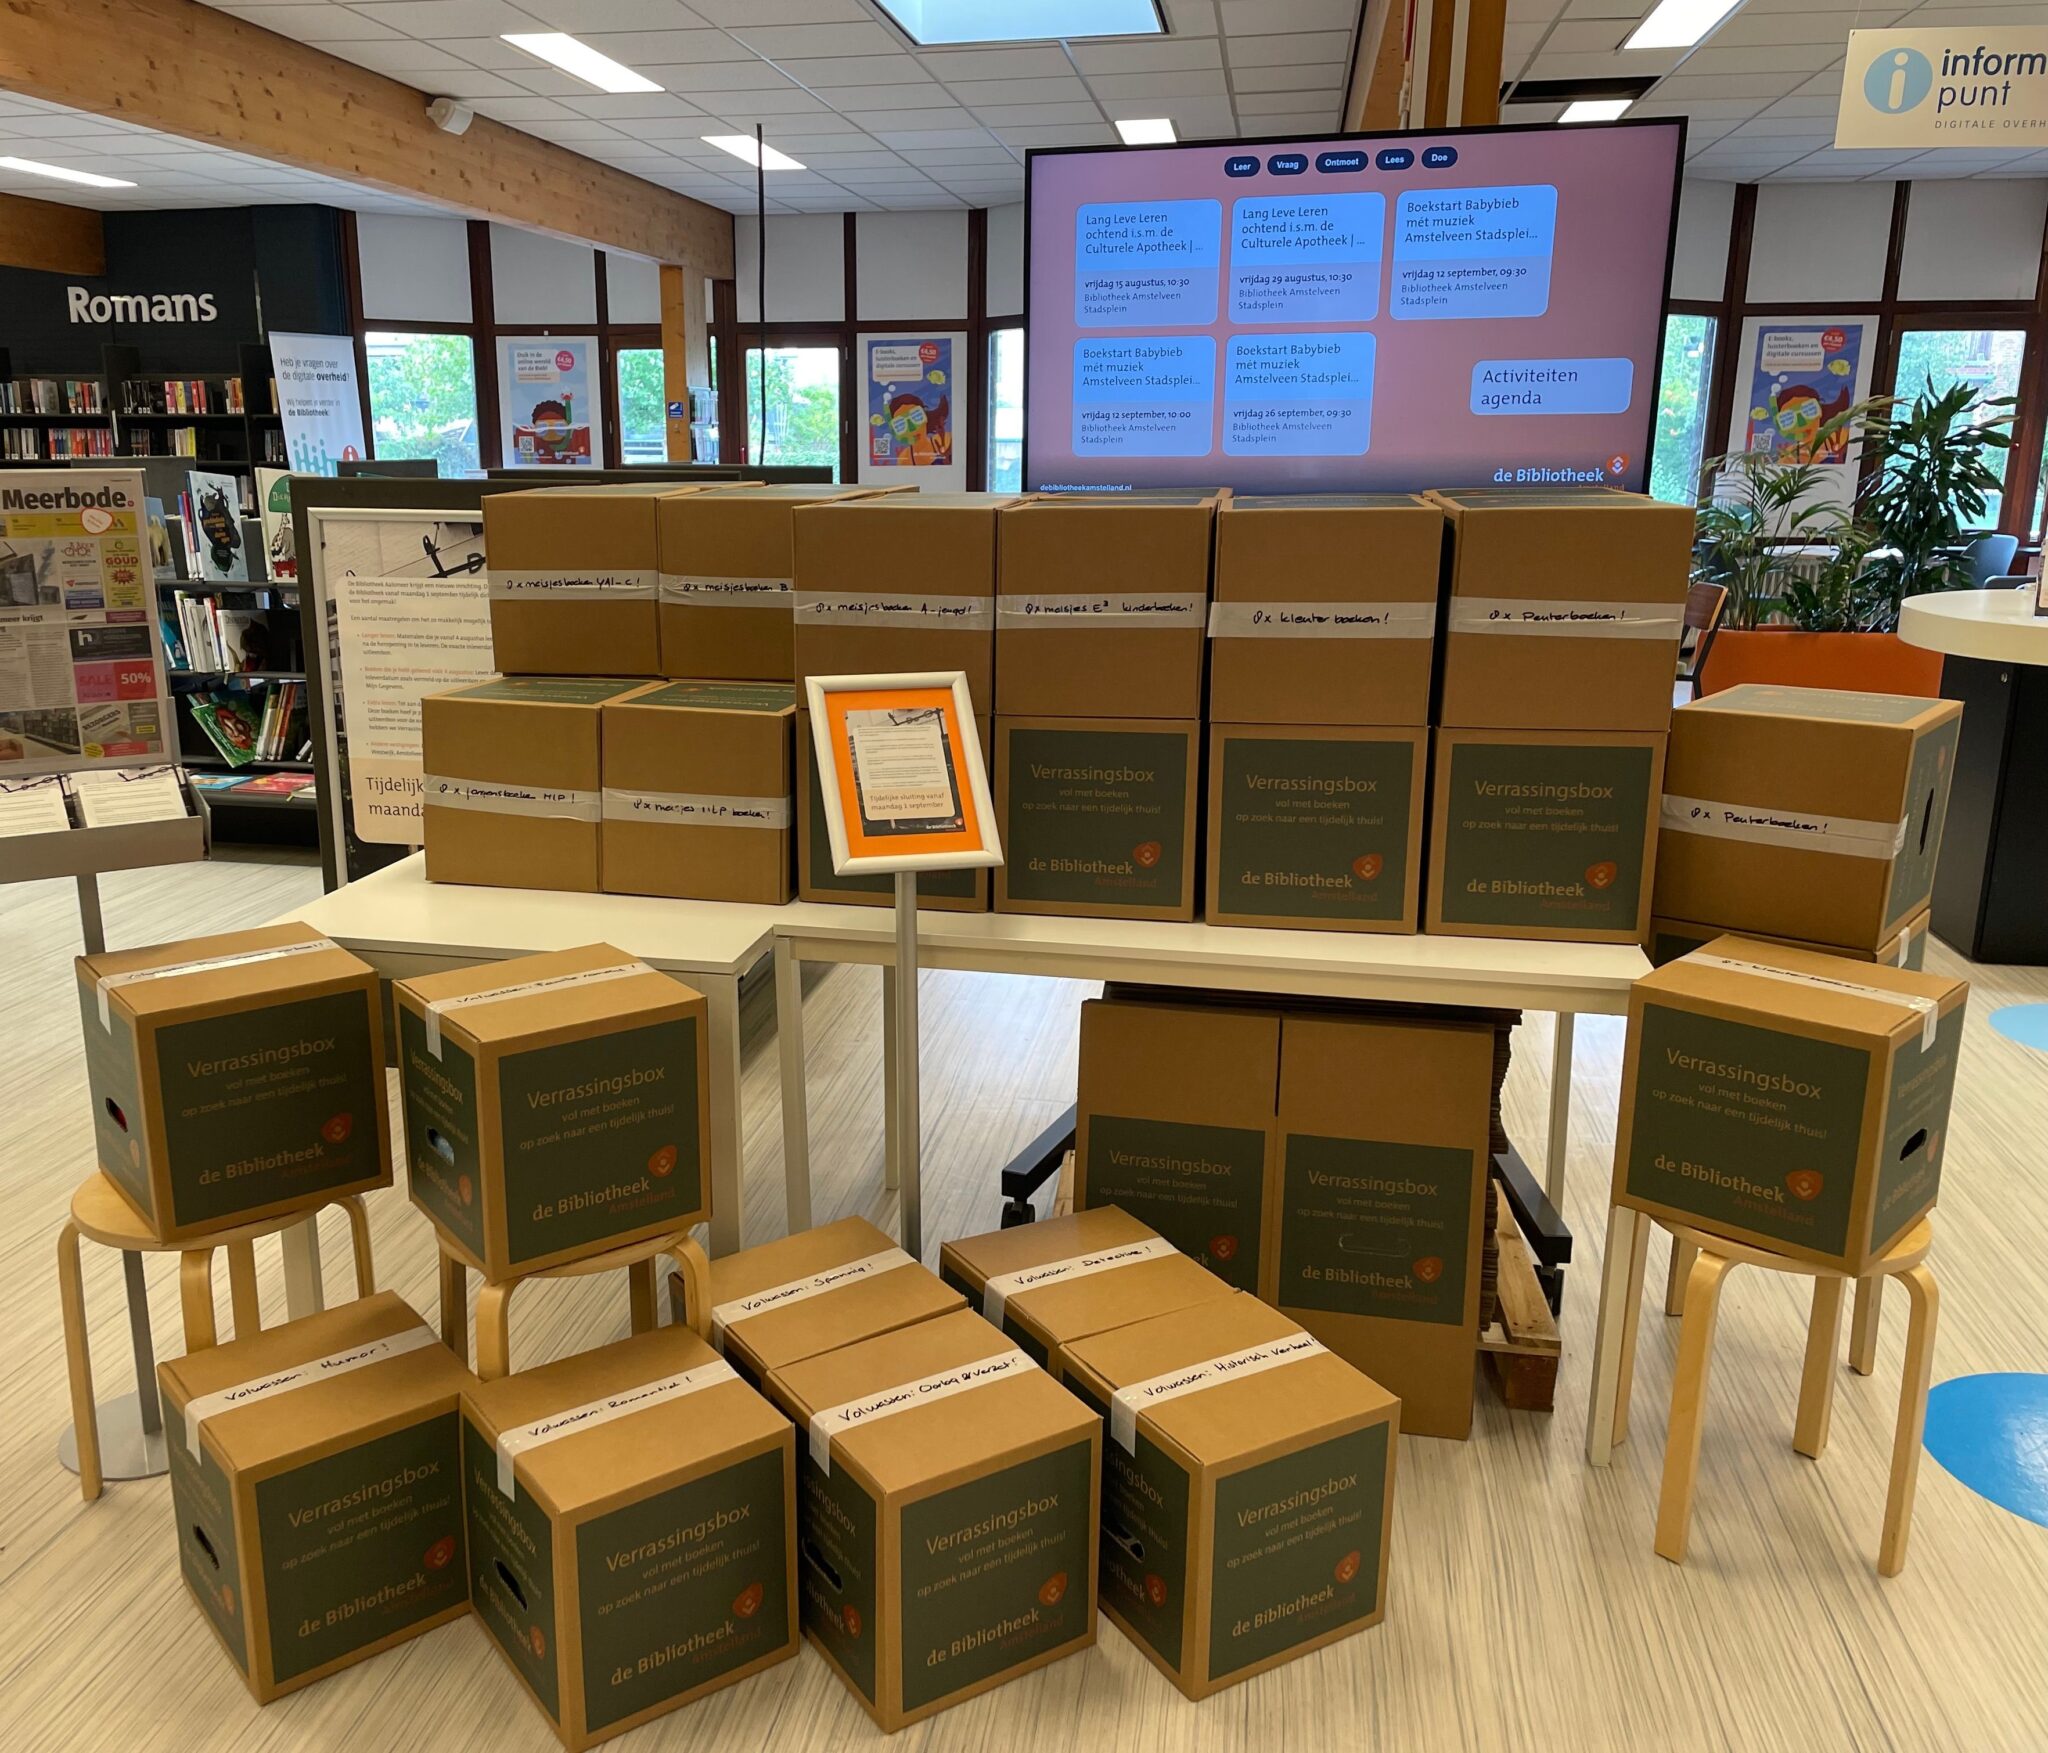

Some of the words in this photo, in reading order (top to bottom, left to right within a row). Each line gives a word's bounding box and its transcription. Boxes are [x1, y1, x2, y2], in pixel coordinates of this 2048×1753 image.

[1942, 46, 2047, 76] inform
[1937, 81, 2011, 113] punt
[1935, 120, 1995, 128] DIGITALE
[2003, 120, 2047, 128] OVERH
[1325, 158, 1359, 167] Ontmoet
[1385, 155, 1404, 164] Lees
[1432, 154, 1448, 162] Doe
[1233, 162, 1251, 171] Leer
[1277, 161, 1299, 170] Vraag
[1407, 200, 1462, 212] Boekstart
[1465, 198, 1519, 212] Babybieb
[1086, 215, 1111, 227] Lang
[1114, 214, 1136, 224] Leve
[1139, 213, 1168, 223] Leren
[1243, 208, 1268, 221] Lang
[1271, 208, 1295, 218] Leve
[1298, 206, 1328, 217] Leren
[1242, 223, 1286, 234] ochtend
[1290, 223, 1318, 233] i.s.m.
[1321, 221, 1334, 231] de
[1406, 217, 1429, 227] mét
[1433, 216, 1475, 226] muziek
[1086, 229, 1128, 239] ochtend
[1131, 228, 1159, 238] i.s.m.
[1160, 227, 1173, 237] de
[1405, 230, 1472, 243] Amstelveen
[1085, 243, 1134, 254] Culturele
[1136, 241, 1186, 254] Apotheek
[1241, 237, 1292, 248] Culturele
[1295, 235, 1347, 248] Apotheek
[1240, 274, 1269, 284] vrijdag
[1272, 276, 1283, 284] 29
[1285, 273, 1327, 283] augustus,
[1329, 273, 1352, 282] 10:30
[1402, 269, 1434, 280] vrijdag
[1447, 268, 1498, 279] september,
[1500, 268, 1527, 278] 09:30
[1085, 280, 1113, 290] vrijdag
[1125, 279, 1166, 289] augustus,
[1168, 278, 1189, 287] 10:30
[1401, 283, 1452, 293] Bibliotheek
[1455, 282, 1508, 291] Amstelveen
[1084, 293, 1130, 301] Bibliotheek
[1133, 291, 1181, 300] Amstelveen
[1239, 288, 1287, 298] Bibliotheek
[1289, 287, 1340, 296] Amstelveen
[67, 286, 217, 323] Romans
[1238, 301, 1283, 311] Stadsplein
[1401, 296, 1447, 306] Stadsplein
[1084, 304, 1127, 314] Stadsplein
[1083, 347, 1132, 358] Boekstart
[1135, 347, 1183, 360] Babybieb
[1236, 345, 1287, 356] Boekstart
[1290, 344, 1341, 357] Babybieb
[281, 358, 294, 366] Heb
[296, 359, 301, 369] je
[303, 360, 323, 369] vragen
[1083, 362, 1104, 372] mét
[1106, 362, 1144, 372] muziek
[1236, 359, 1257, 369] mét
[1261, 359, 1300, 369] muziek
[293, 372, 315, 382] digitale
[1083, 376, 1142, 386] Amstelveen
[1235, 373, 1298, 384] Amstelveen
[1483, 369, 1578, 383] Activiteiten
[1481, 390, 1542, 409] agenda
[1082, 410, 1110, 421] vrijdag
[1122, 410, 1167, 421] september,
[1233, 408, 1263, 419] vrijdag
[1265, 410, 1275, 418] 26
[1277, 408, 1325, 419] september,
[1327, 409, 1351, 418] 09:30
[1494, 468, 1512, 482] de
[1516, 467, 1604, 482] Bibliotheek
[23, 614, 43, 623] krijgt
[121, 673, 150, 684] 50%
[1031, 764, 1155, 784] Verrassingsbox
[366, 777, 424, 797] Tijdelijk
[1246, 774, 1378, 795] Verrassingsbox
[1475, 780, 1613, 801] Verrassingsbox
[870, 795, 899, 803] Tijdelijke
[1275, 800, 1289, 808] vol
[1293, 800, 1311, 808] met
[1314, 800, 1350, 809] boeken
[871, 803, 902, 811] maandag
[909, 801, 943, 809] september
[1236, 814, 1248, 823] op
[1251, 814, 1273, 822] zoek
[1276, 815, 1296, 823] naar
[1320, 815, 1354, 826] tijdelijk
[1357, 816, 1383, 825] thuis!
[1242, 872, 1260, 884] de
[1265, 872, 1352, 888] Bibliotheek
[187, 1037, 336, 1078] Verrassingsbox
[1666, 1047, 1822, 1100] Verrassingsbox
[527, 1065, 665, 1109] Verrassingsbox
[1109, 1150, 1232, 1176] Verrassingsbox
[1308, 1170, 1438, 1197] Verrassingsbox
[1655, 1155, 1676, 1173] de
[1681, 1162, 1784, 1203] Bibliotheek
[532, 1204, 553, 1222] de
[557, 1176, 650, 1215] Bibliotheek
[288, 1458, 440, 1528] Verrassingsbox
[1237, 1473, 1358, 1528] Verrassingsbox
[926, 1493, 1059, 1555] Verrassingsbox
[606, 1503, 751, 1573] Verrassingsbox
[927, 1648, 947, 1667] de
[952, 1607, 1039, 1656] Bibliotheek
[610, 1666, 633, 1686] de
[638, 1620, 734, 1674] Bibliotheek
